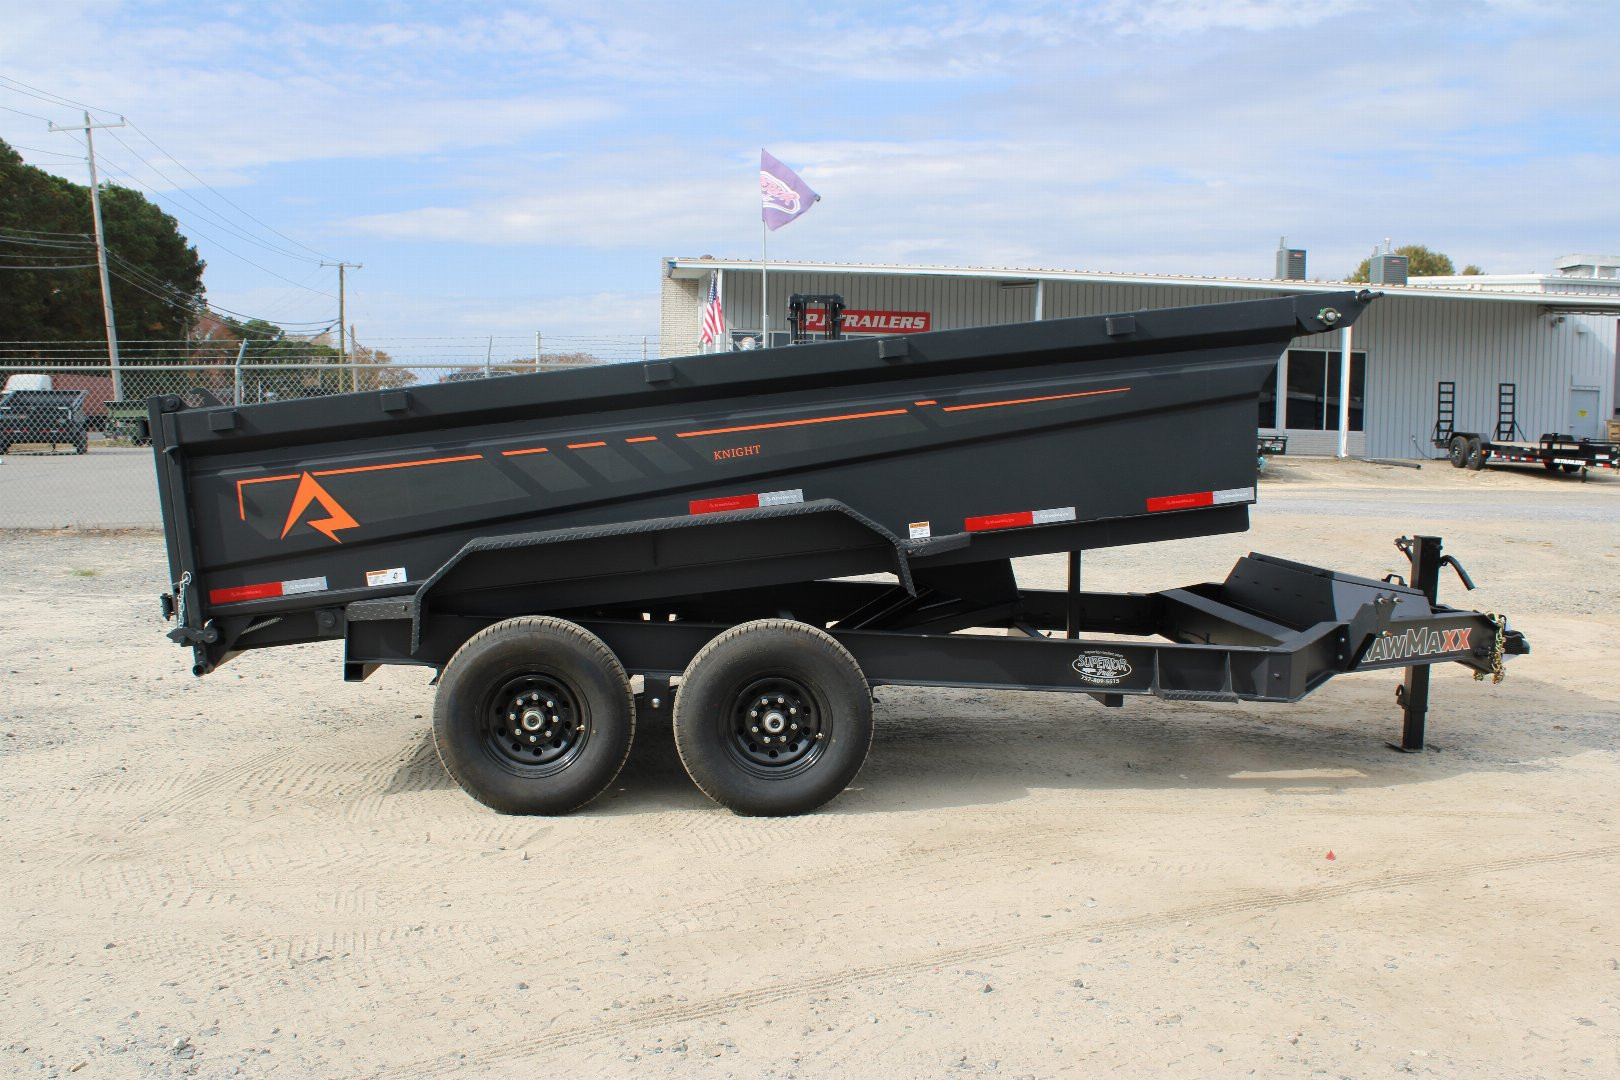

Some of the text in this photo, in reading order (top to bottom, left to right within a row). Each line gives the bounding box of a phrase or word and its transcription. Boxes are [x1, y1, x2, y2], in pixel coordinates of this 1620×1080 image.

[713, 444, 761, 461] KNIGHT
[1361, 626, 1472, 663] AWMAXX
[1077, 654, 1128, 672] SUPERIOR
